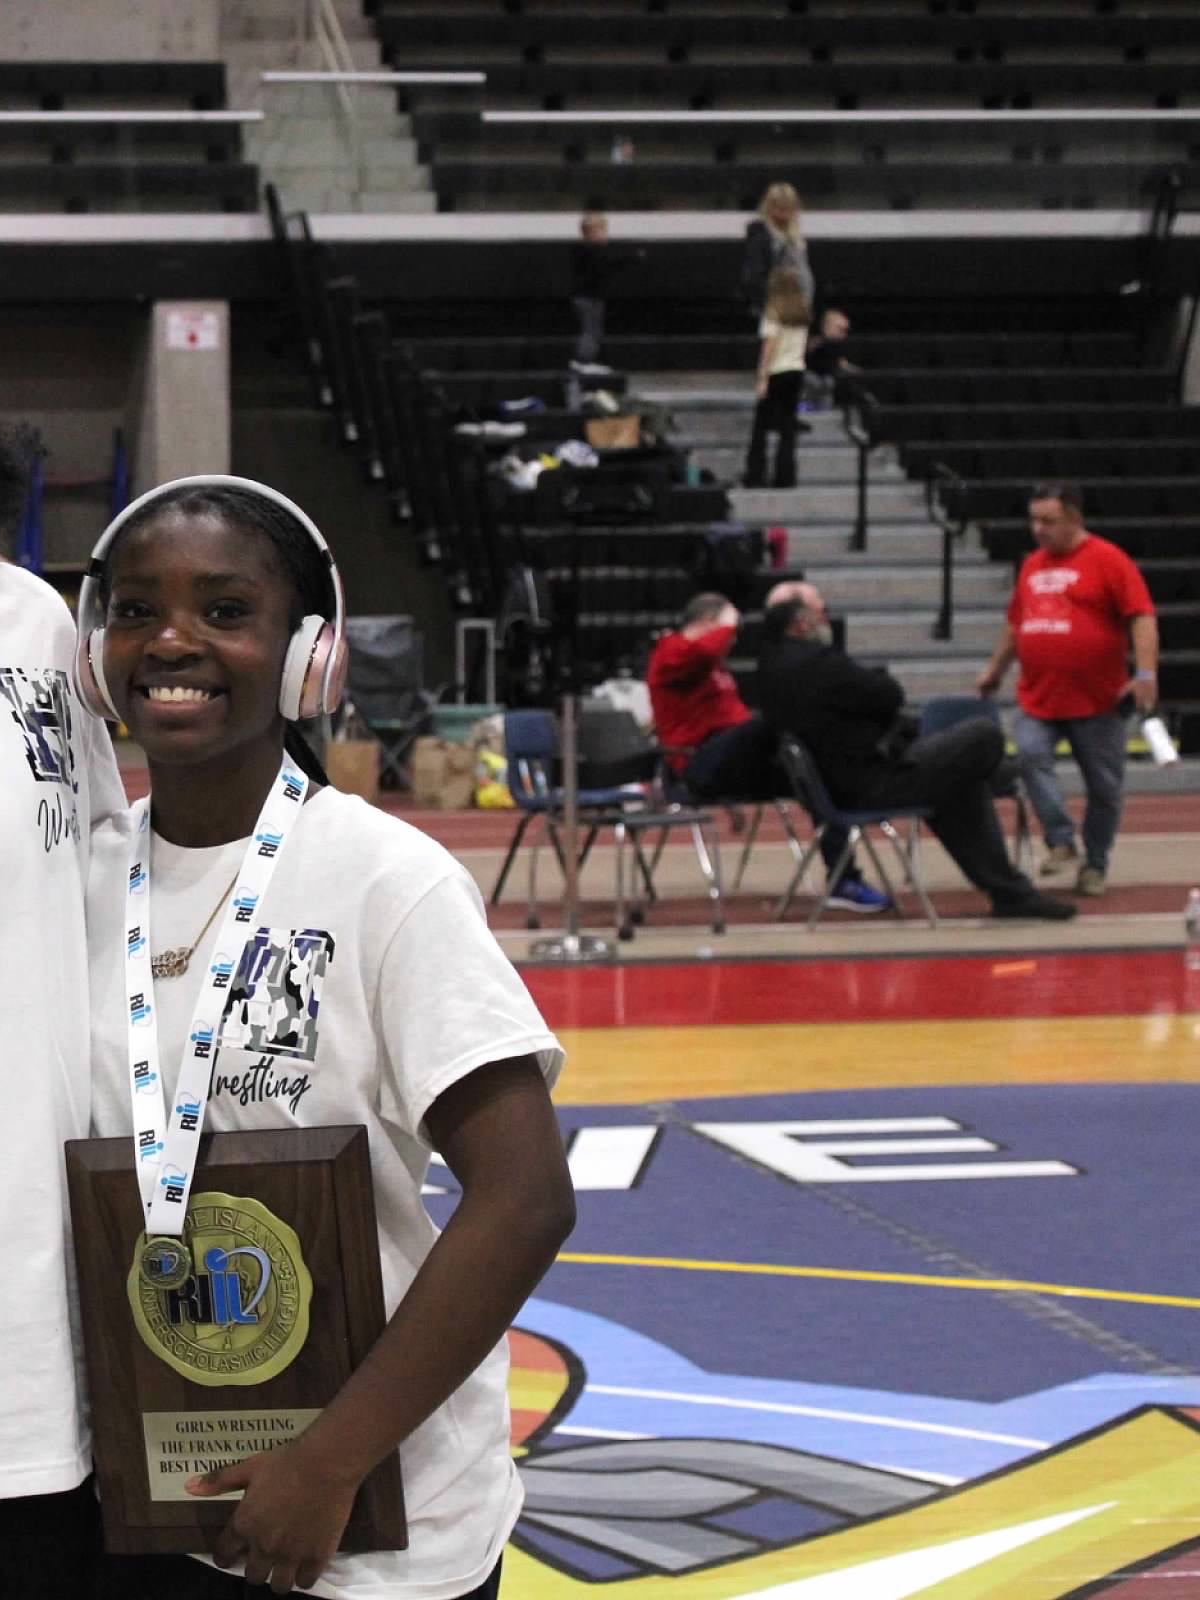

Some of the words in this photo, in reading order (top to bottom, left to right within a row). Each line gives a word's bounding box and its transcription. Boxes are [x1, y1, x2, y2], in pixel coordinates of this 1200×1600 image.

[175, 1420, 215, 1433] GIRLS
[217, 1417, 295, 1432] WRESTLING
[161, 1440, 186, 1454] THE
[189, 1438, 233, 1453] FRANK
[160, 1460, 190, 1473] BEST
